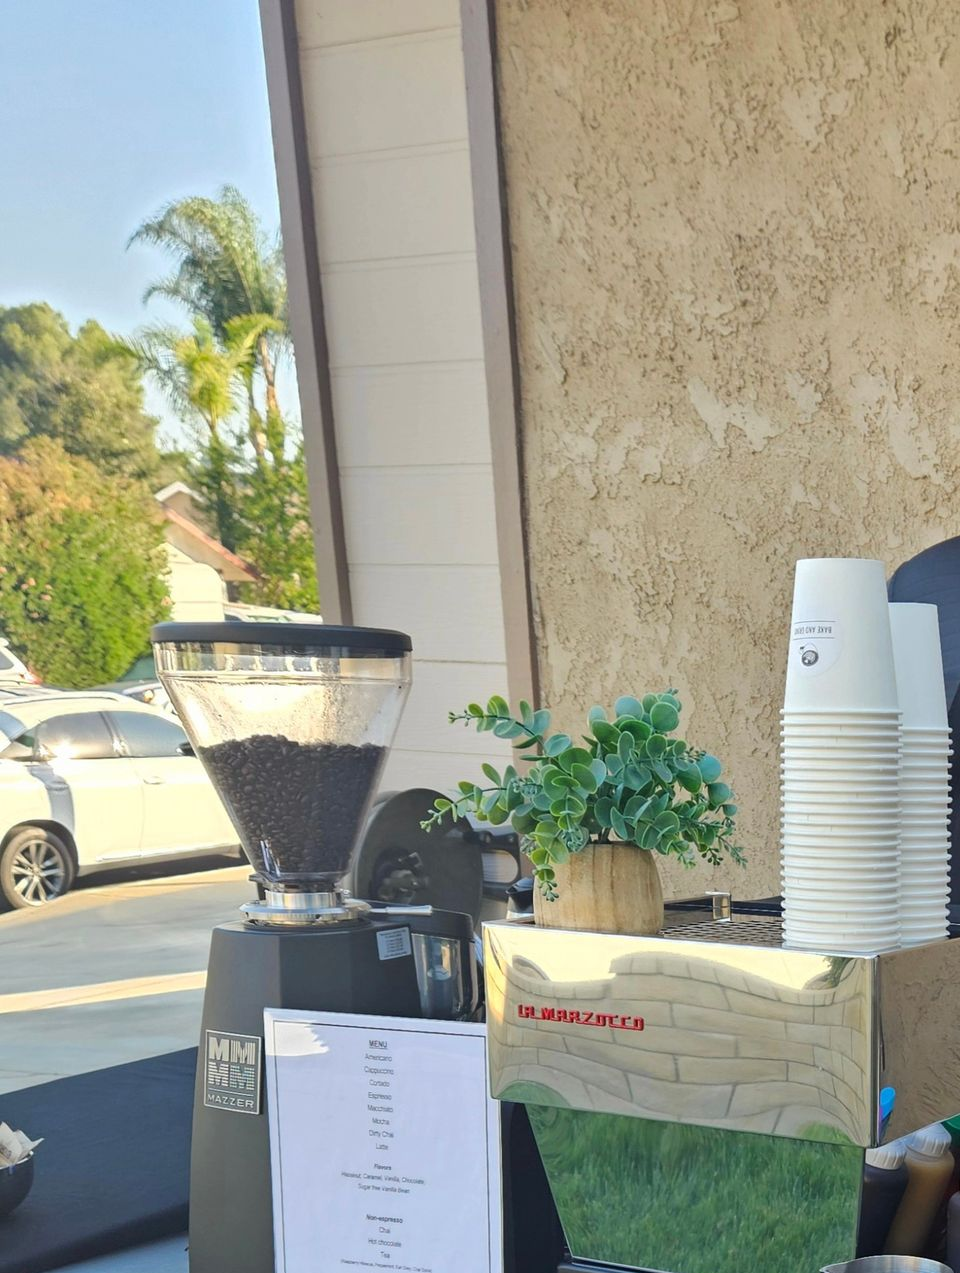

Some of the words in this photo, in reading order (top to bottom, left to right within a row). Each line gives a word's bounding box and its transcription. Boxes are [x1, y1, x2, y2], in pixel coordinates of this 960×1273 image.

[518, 1004, 535, 1019] LA
[541, 1007, 645, 1031] MARZOCCO
[369, 1039, 388, 1048] MENU
[367, 1091, 392, 1100] Espresso
[207, 1094, 255, 1108] MAZZER
[366, 1214, 403, 1224] Non-espresso
